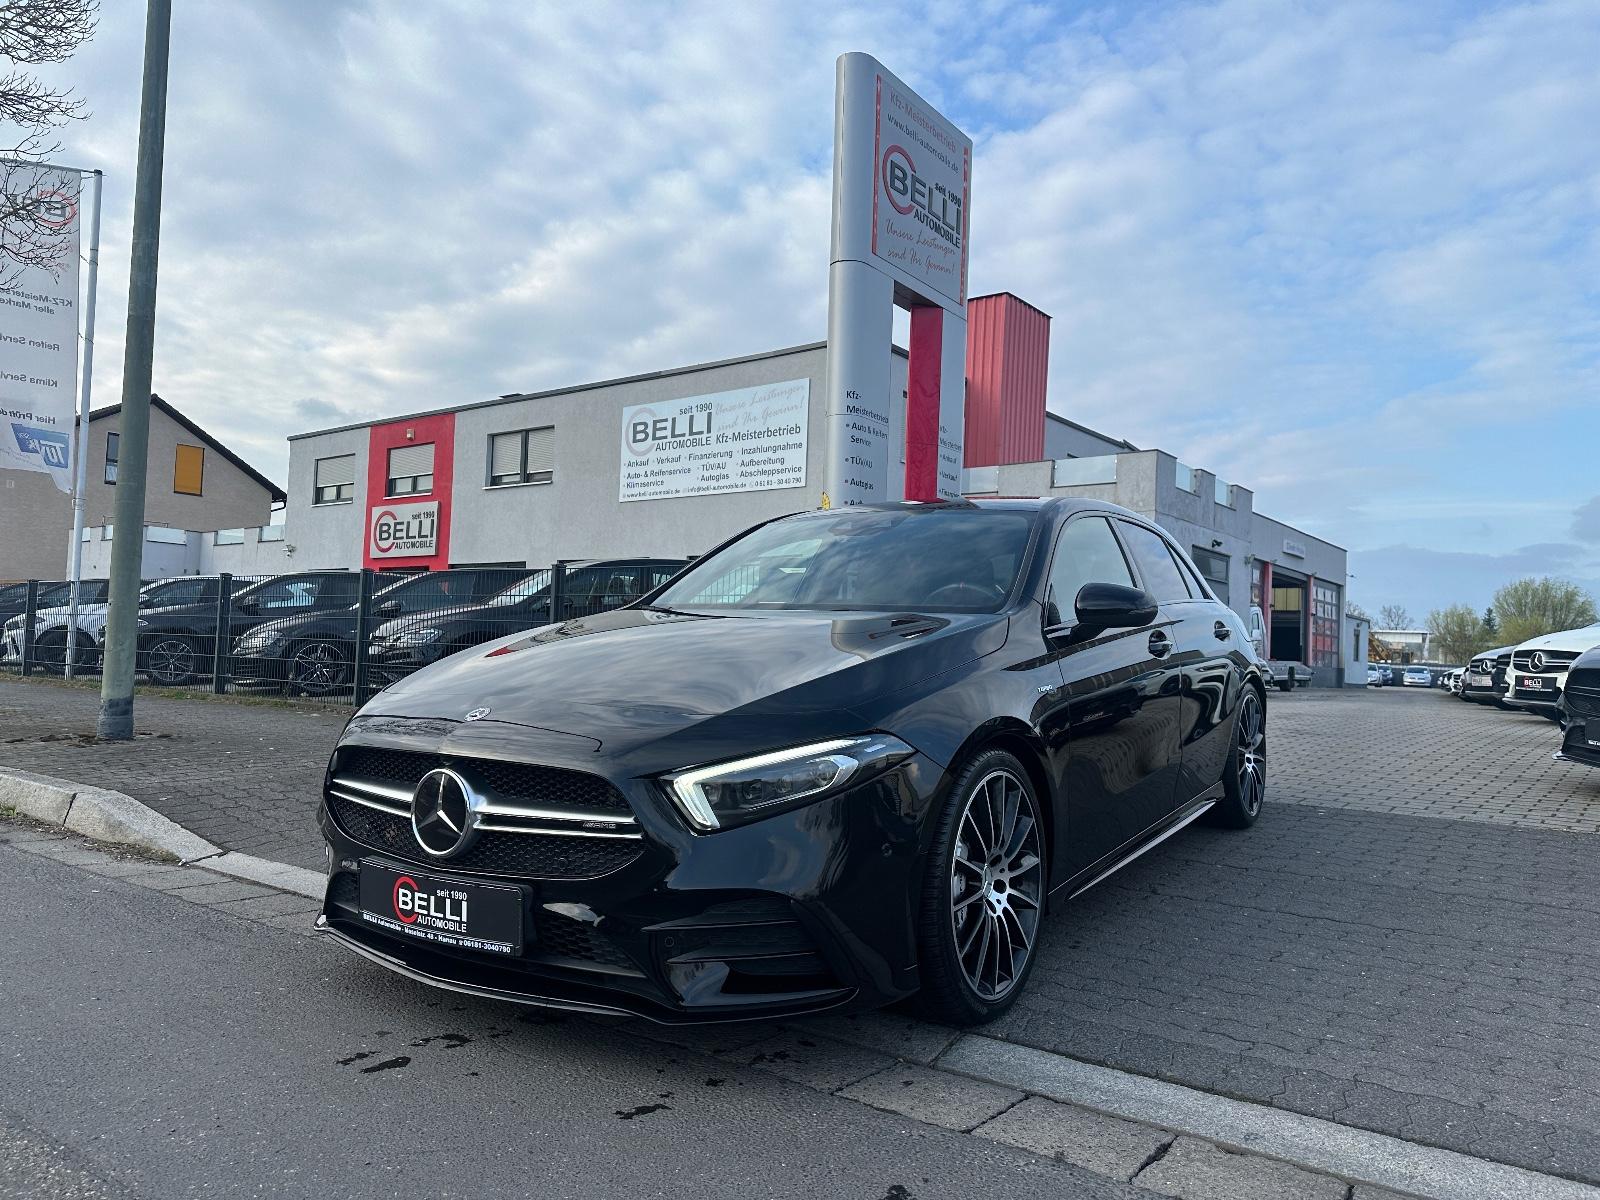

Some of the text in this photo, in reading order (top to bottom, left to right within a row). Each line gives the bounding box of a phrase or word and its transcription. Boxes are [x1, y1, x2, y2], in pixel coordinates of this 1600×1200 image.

[890, 90, 956, 153] Kfz-Meisterbetrieb
[889, 160, 962, 236] BELLI
[934, 182, 962, 208] seit 1990
[886, 219, 913, 241] Unsere
[913, 209, 961, 249] AUTOMOBILE
[887, 249, 906, 262] sind
[846, 390, 862, 400] Kfz-
[679, 402, 713, 415] seit 1990
[846, 404, 889, 423] Meisterbetrieb
[632, 411, 712, 444] BELLI
[716, 423, 801, 444] Kfz-Meisterbetrieb
[851, 422, 866, 433] Auto
[655, 436, 711, 451] AUTOMOBILE
[850, 434, 872, 447] Service
[627, 442, 803, 468] Ankauf Verkauf Finanzierung Inzahlungnahme
[740, 457, 785, 468] Aufbereitung
[626, 471, 642, 480] Auto-
[650, 467, 692, 478] Reifenservice
[700, 473, 730, 482] Autoglas
[740, 465, 802, 478] Abschleppservice
[626, 479, 665, 489] Klimaservice
[411, 510, 435, 520] seit 1990
[378, 518, 435, 541] BELLI
[394, 540, 434, 550] AUTOMOBILE
[436, 889, 467, 900] seit 1990
[398, 888, 468, 922] BELLI
[417, 915, 467, 933] AUTOMOBILE
[438, 935, 457, 945] Hanau
